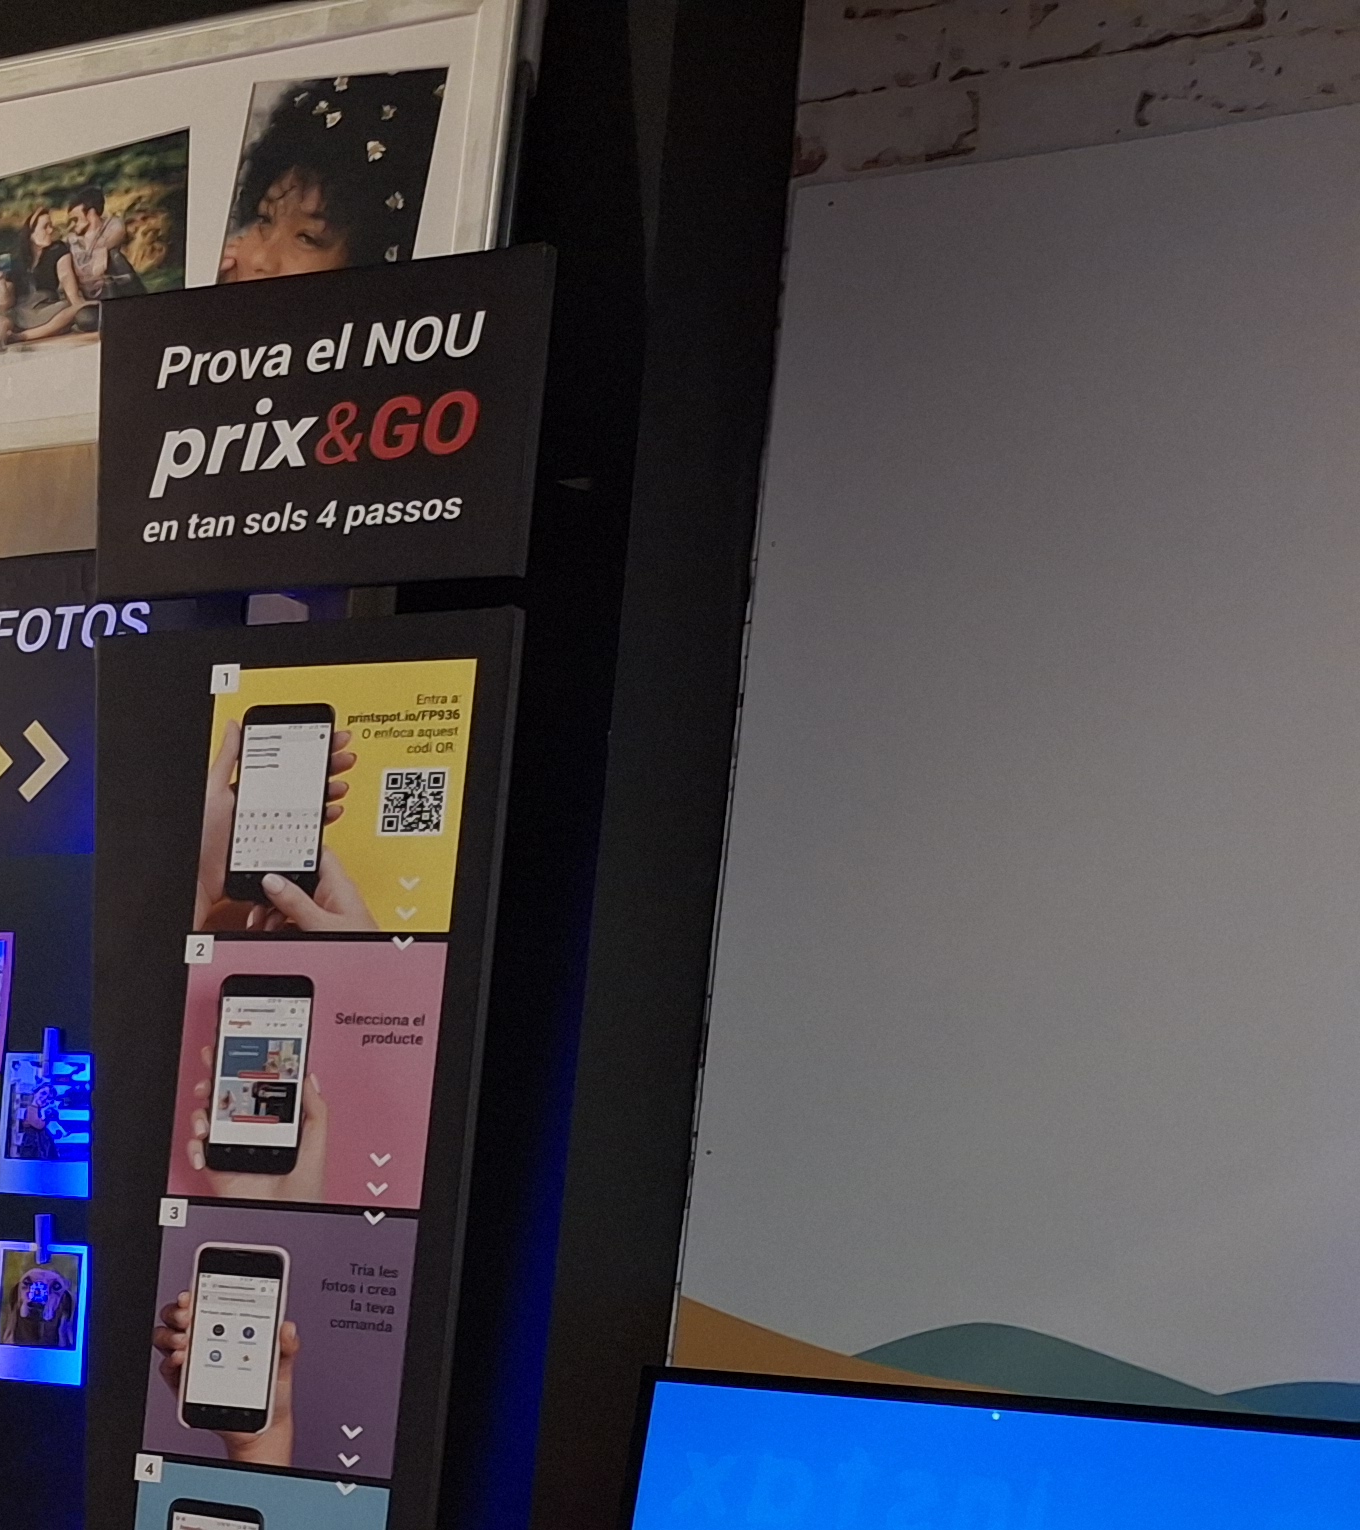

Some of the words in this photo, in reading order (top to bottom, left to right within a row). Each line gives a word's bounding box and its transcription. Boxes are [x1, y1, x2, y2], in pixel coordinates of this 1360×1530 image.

[156, 341, 292, 390] Prova
[306, 323, 353, 373] el
[363, 310, 486, 368] NOU
[148, 389, 480, 499] prix&GO
[142, 518, 178, 544] en
[187, 512, 236, 540] tan
[243, 502, 308, 536] sols
[315, 500, 338, 530] 4
[342, 496, 463, 535] passos
[222, 672, 230, 687] 1
[416, 694, 448, 706] Entra
[347, 708, 461, 726] printspot.io/FP936
[362, 728, 372, 740] O
[374, 727, 414, 739] enfoca
[417, 726, 459, 740] aquest
[406, 742, 432, 754] codi
[194, 943, 206, 958] 2
[335, 1012, 409, 1026] Selecciona
[412, 1013, 426, 1026] el
[361, 1031, 424, 1047] producte
[169, 1206, 180, 1221] 3
[349, 1263, 375, 1276] Tria
[379, 1265, 399, 1278] les
[321, 1278, 356, 1293] fotos
[359, 1282, 364, 1294] i
[367, 1285, 397, 1296] crea
[350, 1299, 362, 1312] la
[366, 1302, 395, 1315] teva
[330, 1318, 393, 1333] comanda
[144, 1462, 155, 1477] 4
